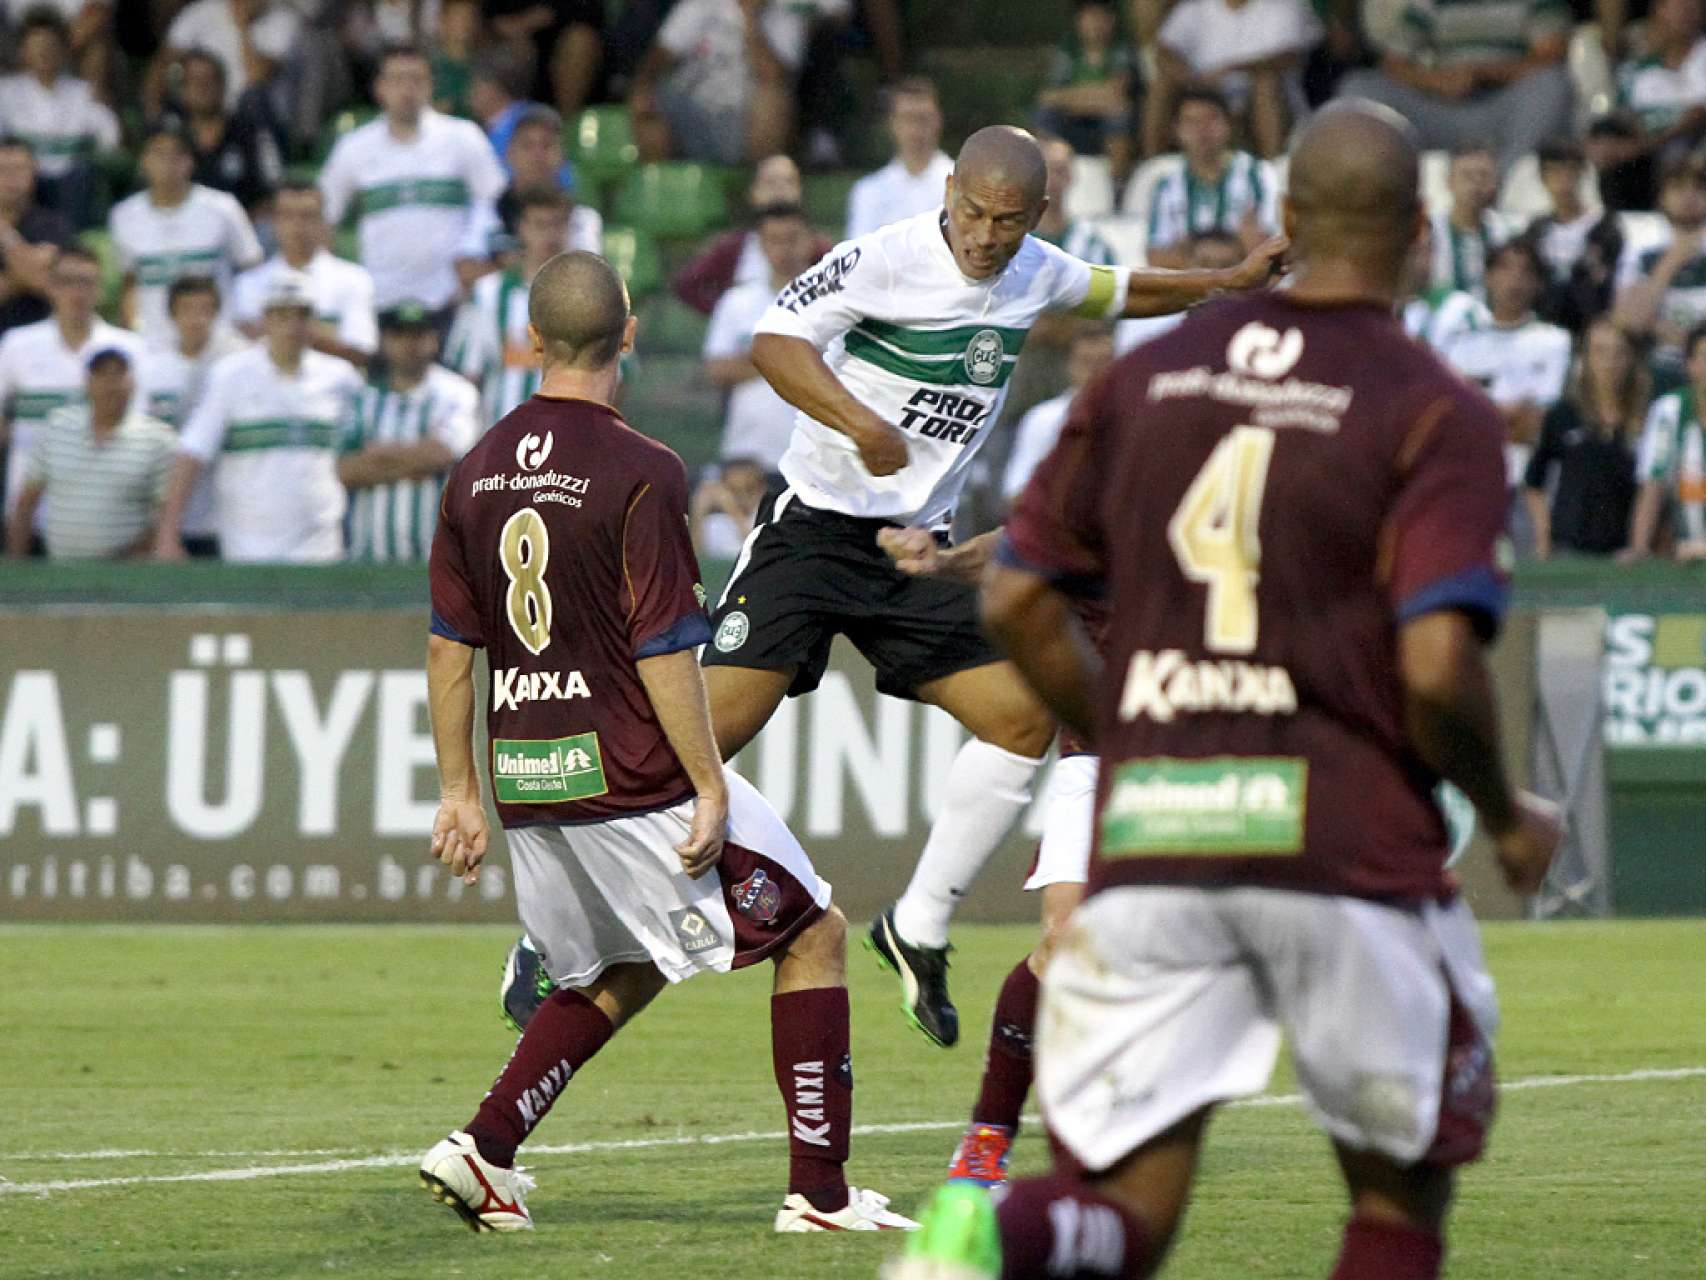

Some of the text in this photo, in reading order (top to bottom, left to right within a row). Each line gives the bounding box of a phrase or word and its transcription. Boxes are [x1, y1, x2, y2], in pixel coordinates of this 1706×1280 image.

[471, 469, 590, 497] prati-donaduzzi
[500, 507, 553, 655] 8
[1168, 425, 1275, 653] 4
[1118, 648, 1298, 723] KANXA
[167, 633, 439, 838] ÜYE
[497, 751, 559, 775] Unimed
[792, 1060, 831, 1146] KANXA
